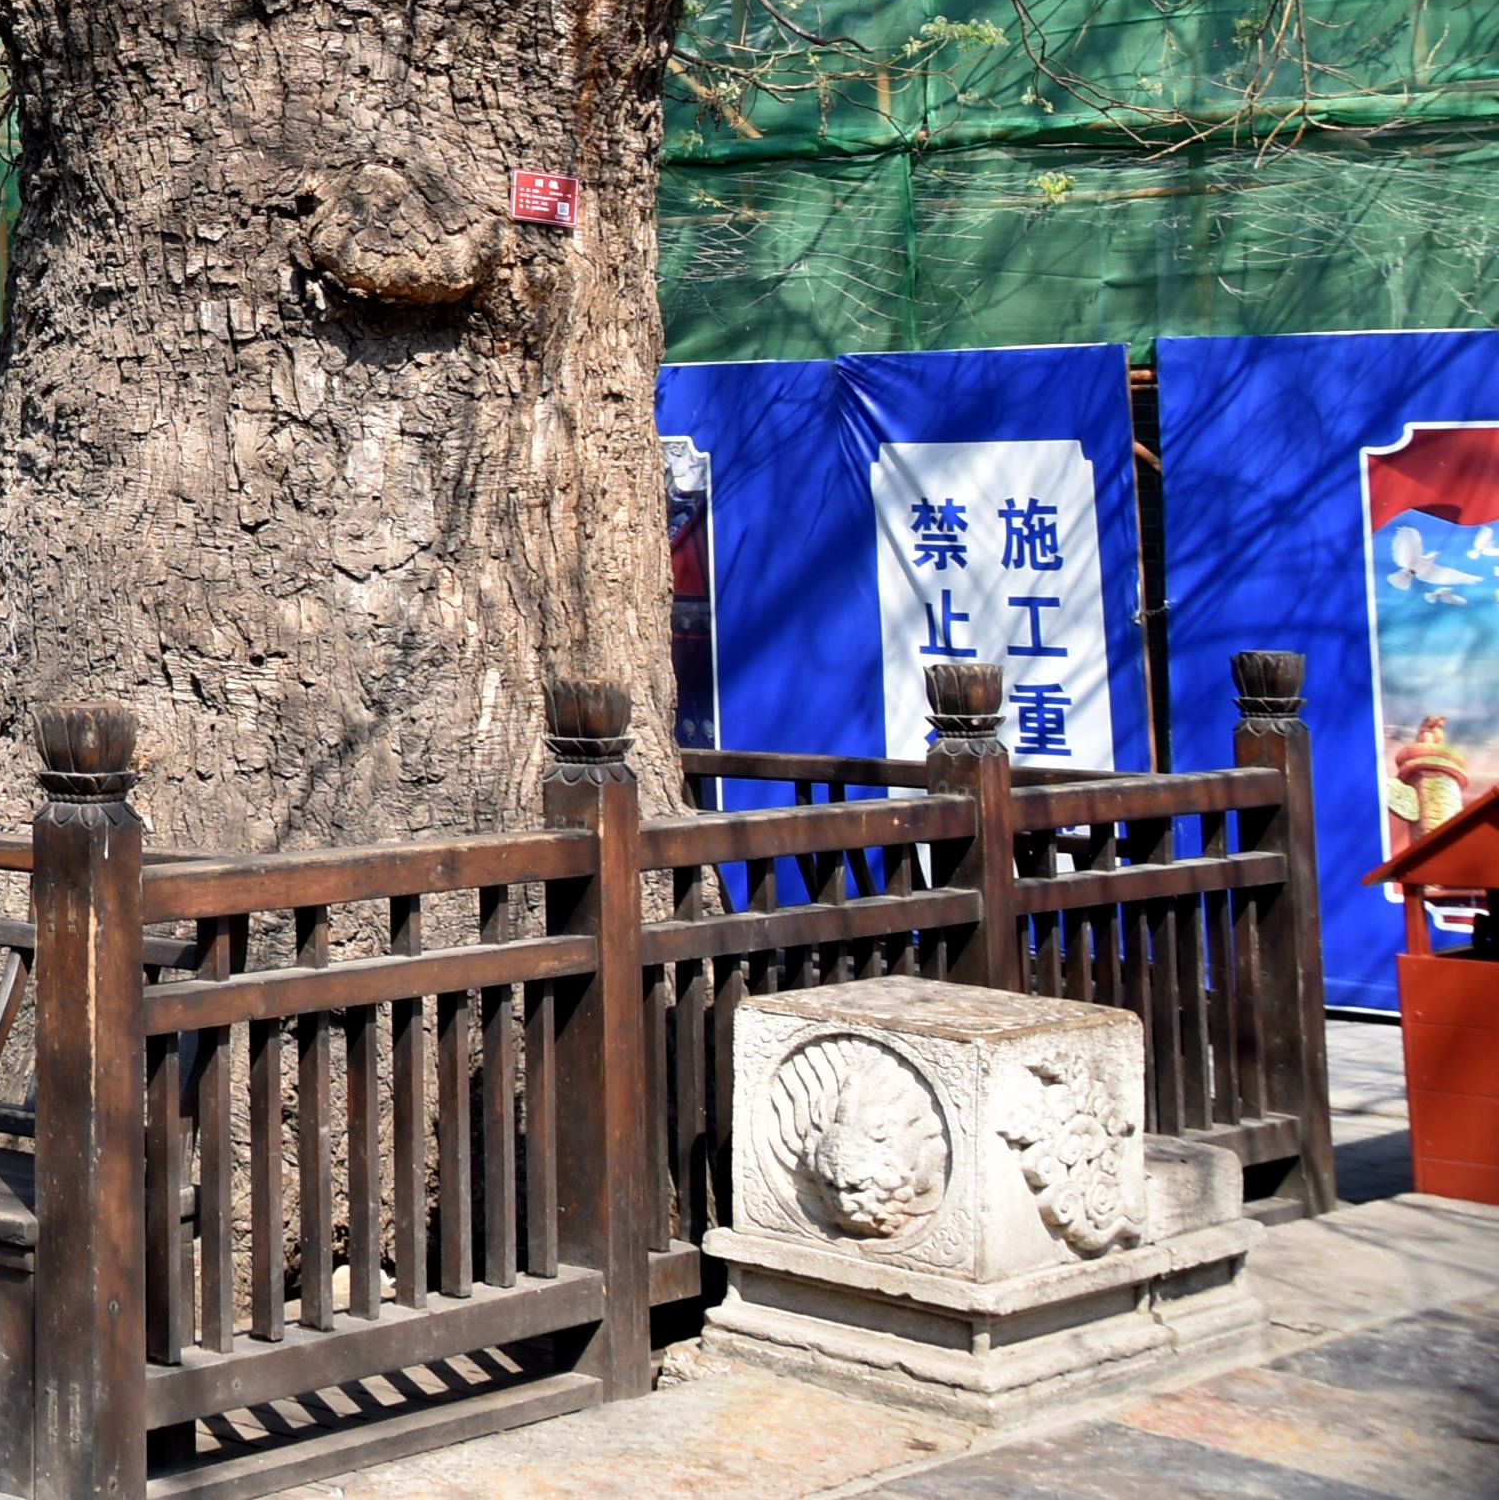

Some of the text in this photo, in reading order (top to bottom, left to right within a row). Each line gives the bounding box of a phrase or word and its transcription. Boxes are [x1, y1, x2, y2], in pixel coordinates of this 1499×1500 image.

[910, 496, 979, 746] 禁止
[998, 496, 1073, 757] 施工重
